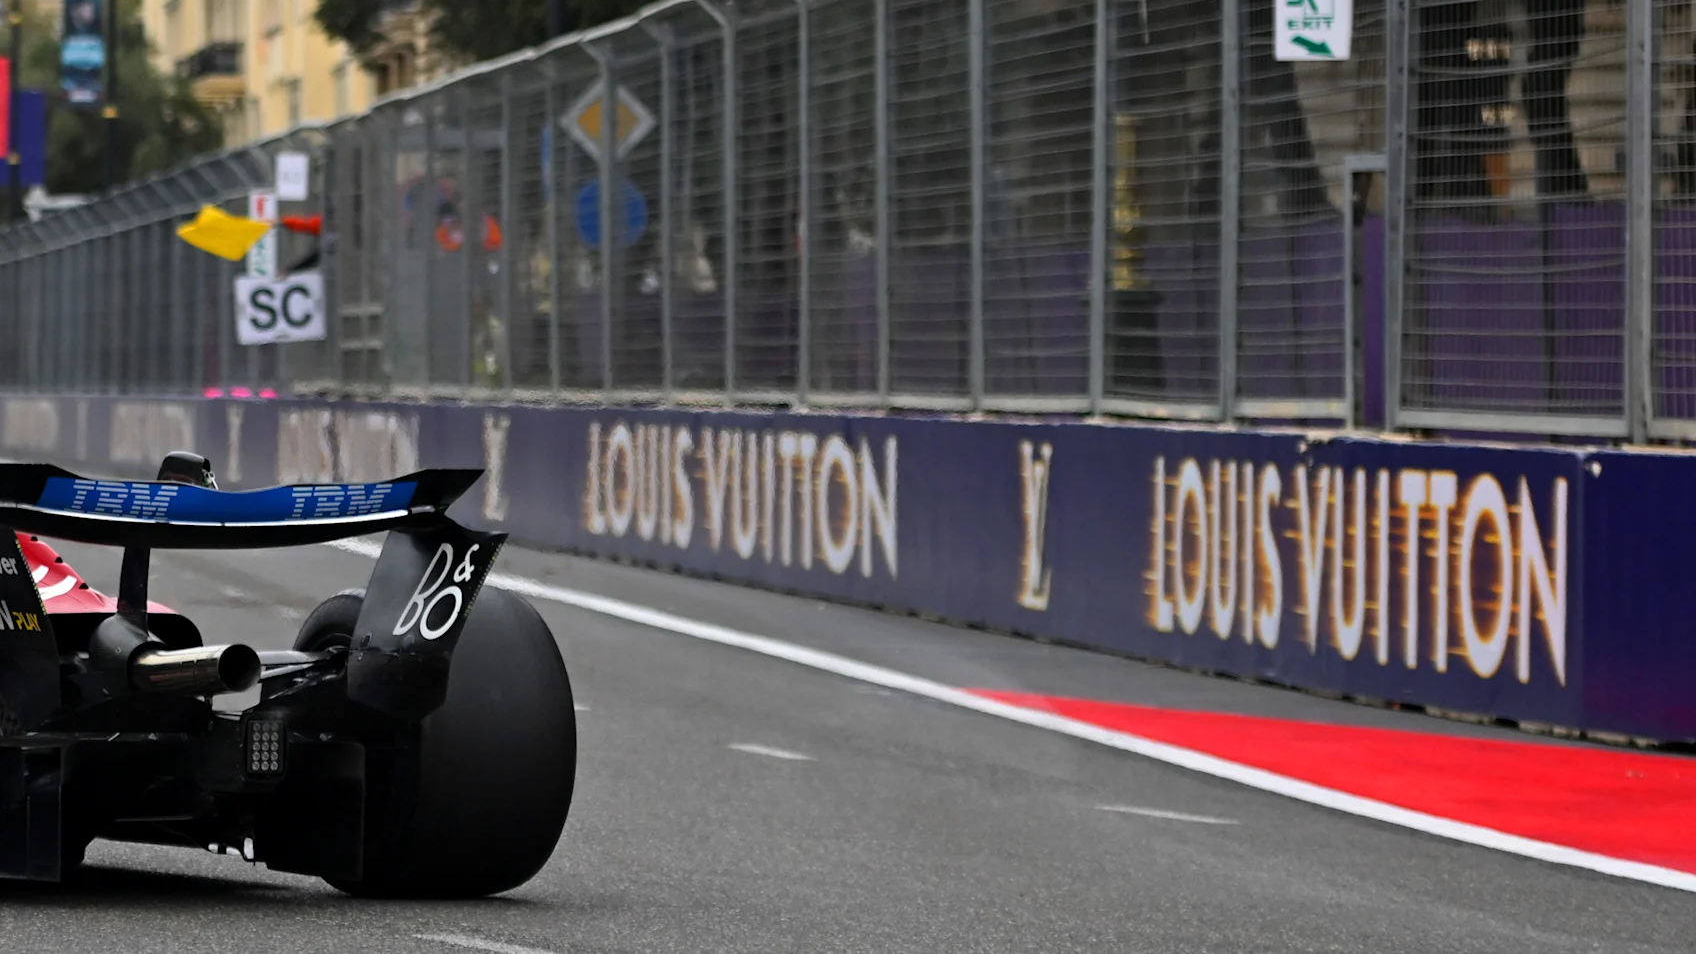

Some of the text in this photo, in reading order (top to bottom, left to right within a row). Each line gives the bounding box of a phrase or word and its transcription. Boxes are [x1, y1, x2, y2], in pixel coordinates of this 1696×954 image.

[1288, 19, 1334, 31] EXIT
[249, 285, 312, 331] SC
[70, 480, 179, 520] IBM
[290, 483, 393, 519] IBM
[587, 421, 694, 548] LOUIS
[705, 425, 898, 580] VUITTON
[1154, 455, 1569, 687] LOUIS VUITTON
[12, 611, 42, 632] PLAY
